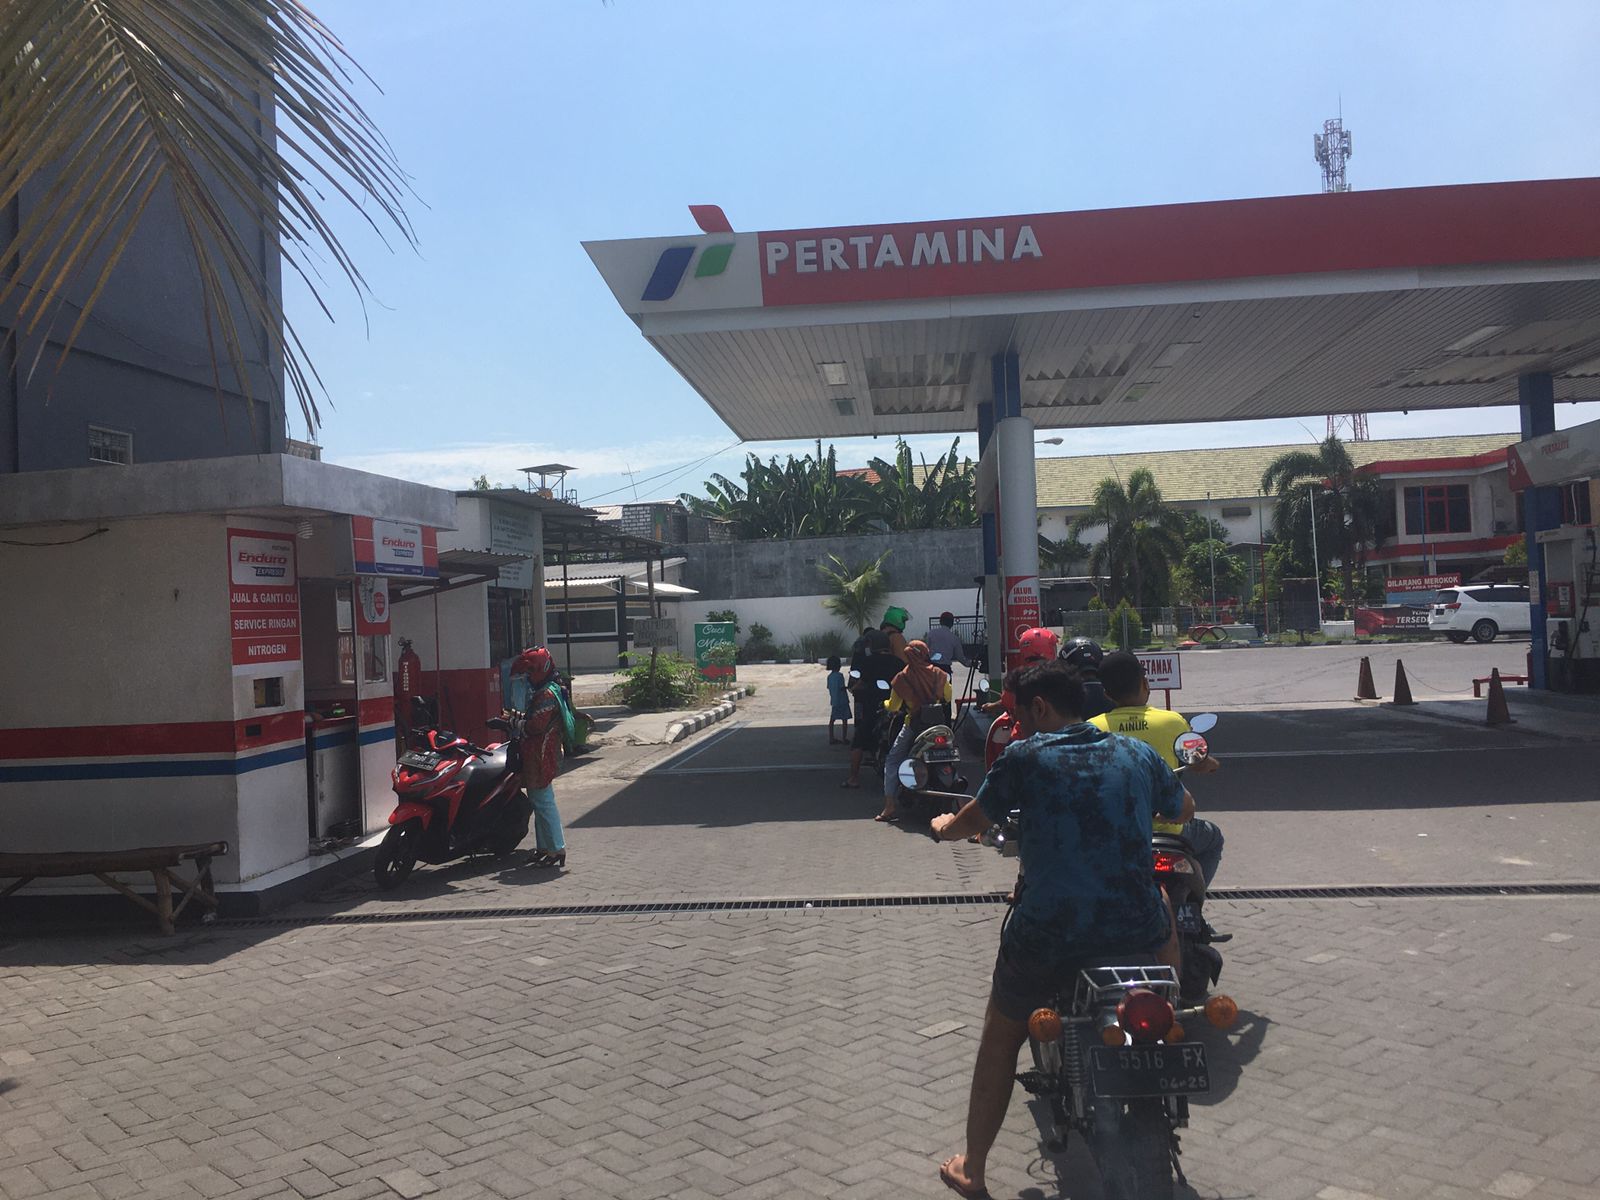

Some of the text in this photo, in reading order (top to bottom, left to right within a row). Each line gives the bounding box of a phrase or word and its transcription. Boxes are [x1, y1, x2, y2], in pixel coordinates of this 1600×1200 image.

[765, 225, 1043, 275] PERTAMINA
[1510, 459, 1517, 475] 3
[382, 537, 415, 548] Enduro
[239, 552, 287, 564] Enduro
[1387, 576, 1458, 587] DILARANG MEROKOK
[231, 592, 297, 604] JUAL & GANTI OLI
[234, 618, 296, 630] SERVICE RINGAN
[703, 625, 726, 635] Cuci
[248, 644, 287, 656] NITROGEN
[1118, 721, 1149, 732] AINUR
[1095, 1047, 1205, 1071] L 5516 FX
